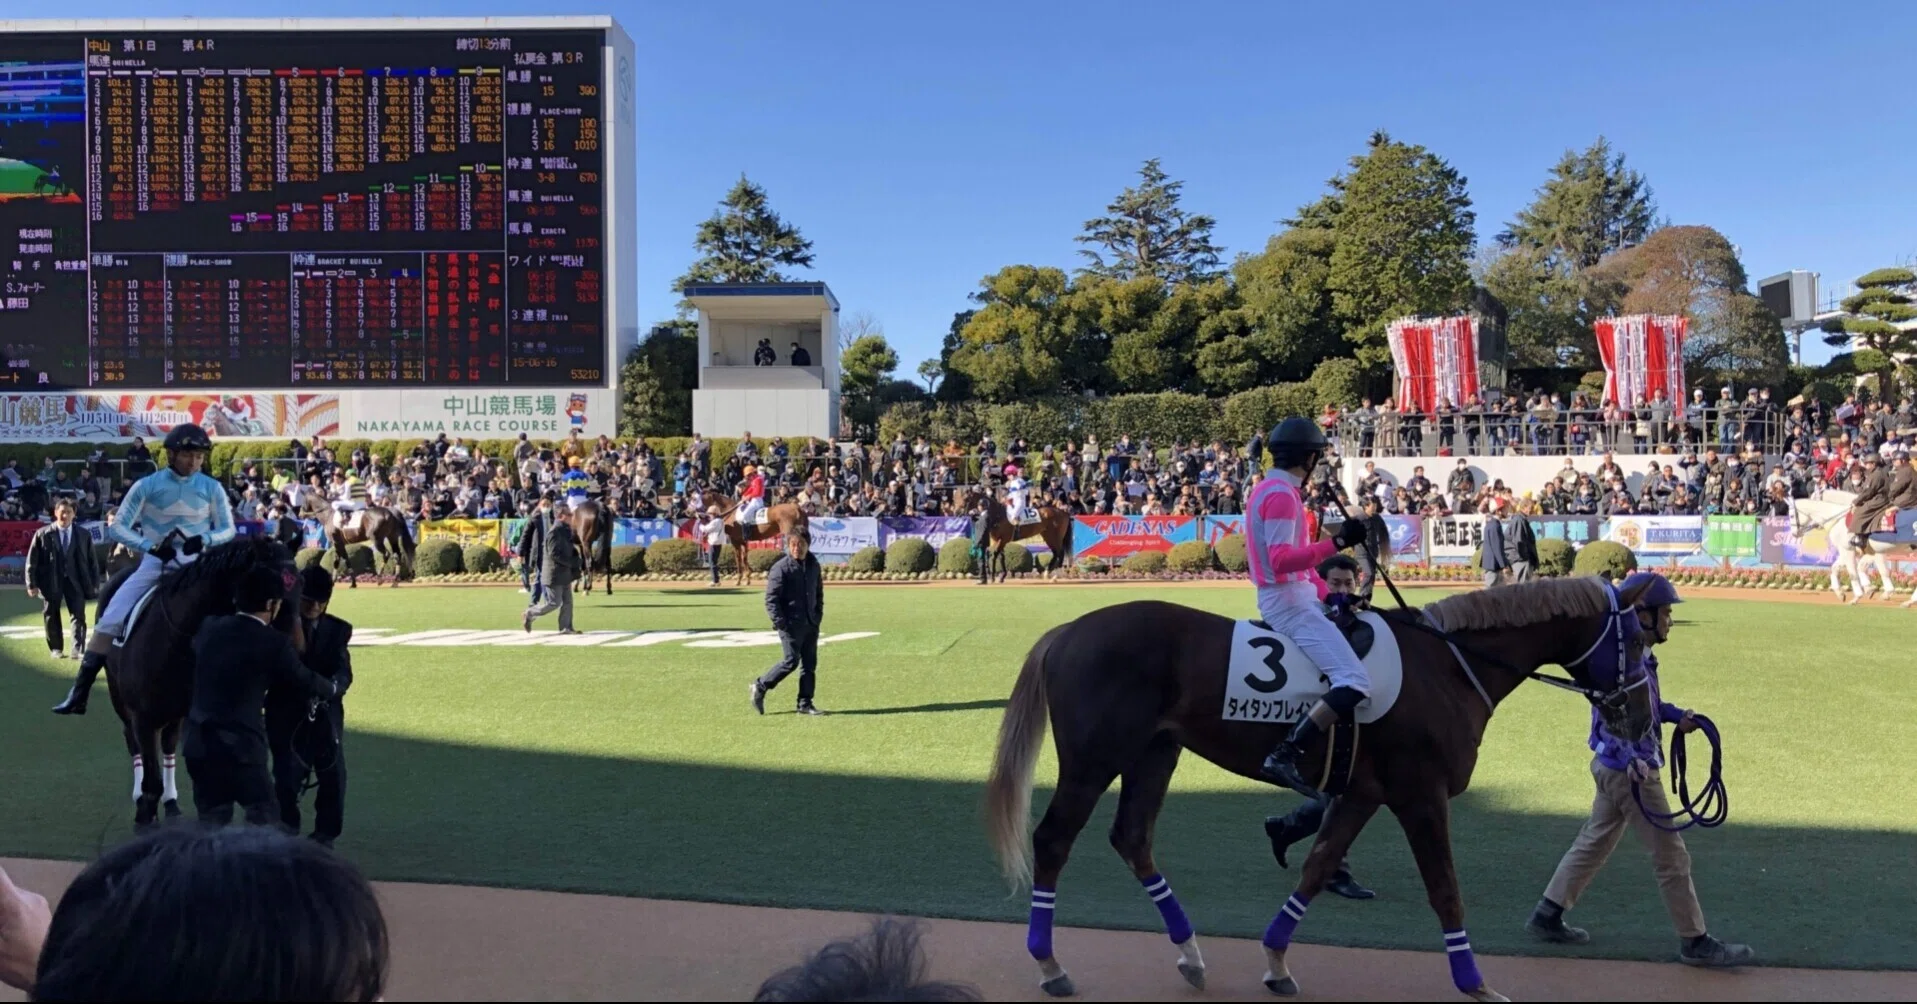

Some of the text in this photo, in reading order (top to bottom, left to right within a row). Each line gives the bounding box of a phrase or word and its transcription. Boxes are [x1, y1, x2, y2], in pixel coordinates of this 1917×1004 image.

[88, 40, 214, 52] 中山 第1日 第4R
[108, 69, 112, 78] 1
[152, 68, 160, 78] 2
[200, 67, 206, 77] 3
[245, 68, 252, 77] 4
[292, 67, 299, 77] 5
[338, 67, 345, 77] 6
[430, 67, 436, 76] 8
[476, 66, 482, 76] 9
[95, 78, 100, 87] 2
[141, 78, 146, 87] 3
[187, 78, 193, 87] 4
[234, 78, 239, 86] 5
[280, 78, 286, 86] 6
[326, 77, 332, 86] 7
[373, 77, 378, 86] 8
[419, 77, 424, 85] 9
[460, 76, 470, 85] 10
[95, 88, 101, 96] 3
[414, 86, 424, 95] 10
[460, 86, 470, 95] 11
[543, 86, 554, 96] 15
[95, 97, 101, 106] 4
[188, 97, 193, 106] 6
[414, 96, 424, 105] 11
[188, 106, 193, 115] 7
[188, 116, 193, 125] 8
[533, 119, 537, 128] 1
[544, 119, 555, 128] 15
[96, 126, 101, 134] 7
[142, 126, 147, 134] 8
[532, 130, 538, 139] 2
[548, 129, 555, 139] 6
[461, 134, 470, 142] 16
[137, 145, 147, 154] 10
[532, 140, 597, 150] 3 16 1010
[475, 163, 486, 173] 10
[429, 173, 439, 183] 11
[579, 172, 597, 183] 670
[384, 183, 394, 193] 12
[338, 193, 348, 202] 13
[292, 203, 303, 212] 14
[246, 212, 257, 222] 15
[509, 256, 546, 266] ワイド
[307, 269, 408, 279] 1 2 3 4
[307, 361, 313, 370] 8
[93, 372, 99, 380] 9
[167, 372, 174, 380] 9
[571, 369, 599, 380] 53210
[444, 395, 556, 416] 中山競馬場
[358, 420, 558, 432] NAKAYAMA RACE COURSE
[1024, 509, 1037, 519] 15
[1095, 520, 1176, 536] CADENAS
[1651, 530, 1696, 538] T.KURITA
[1244, 636, 1288, 693] 3
